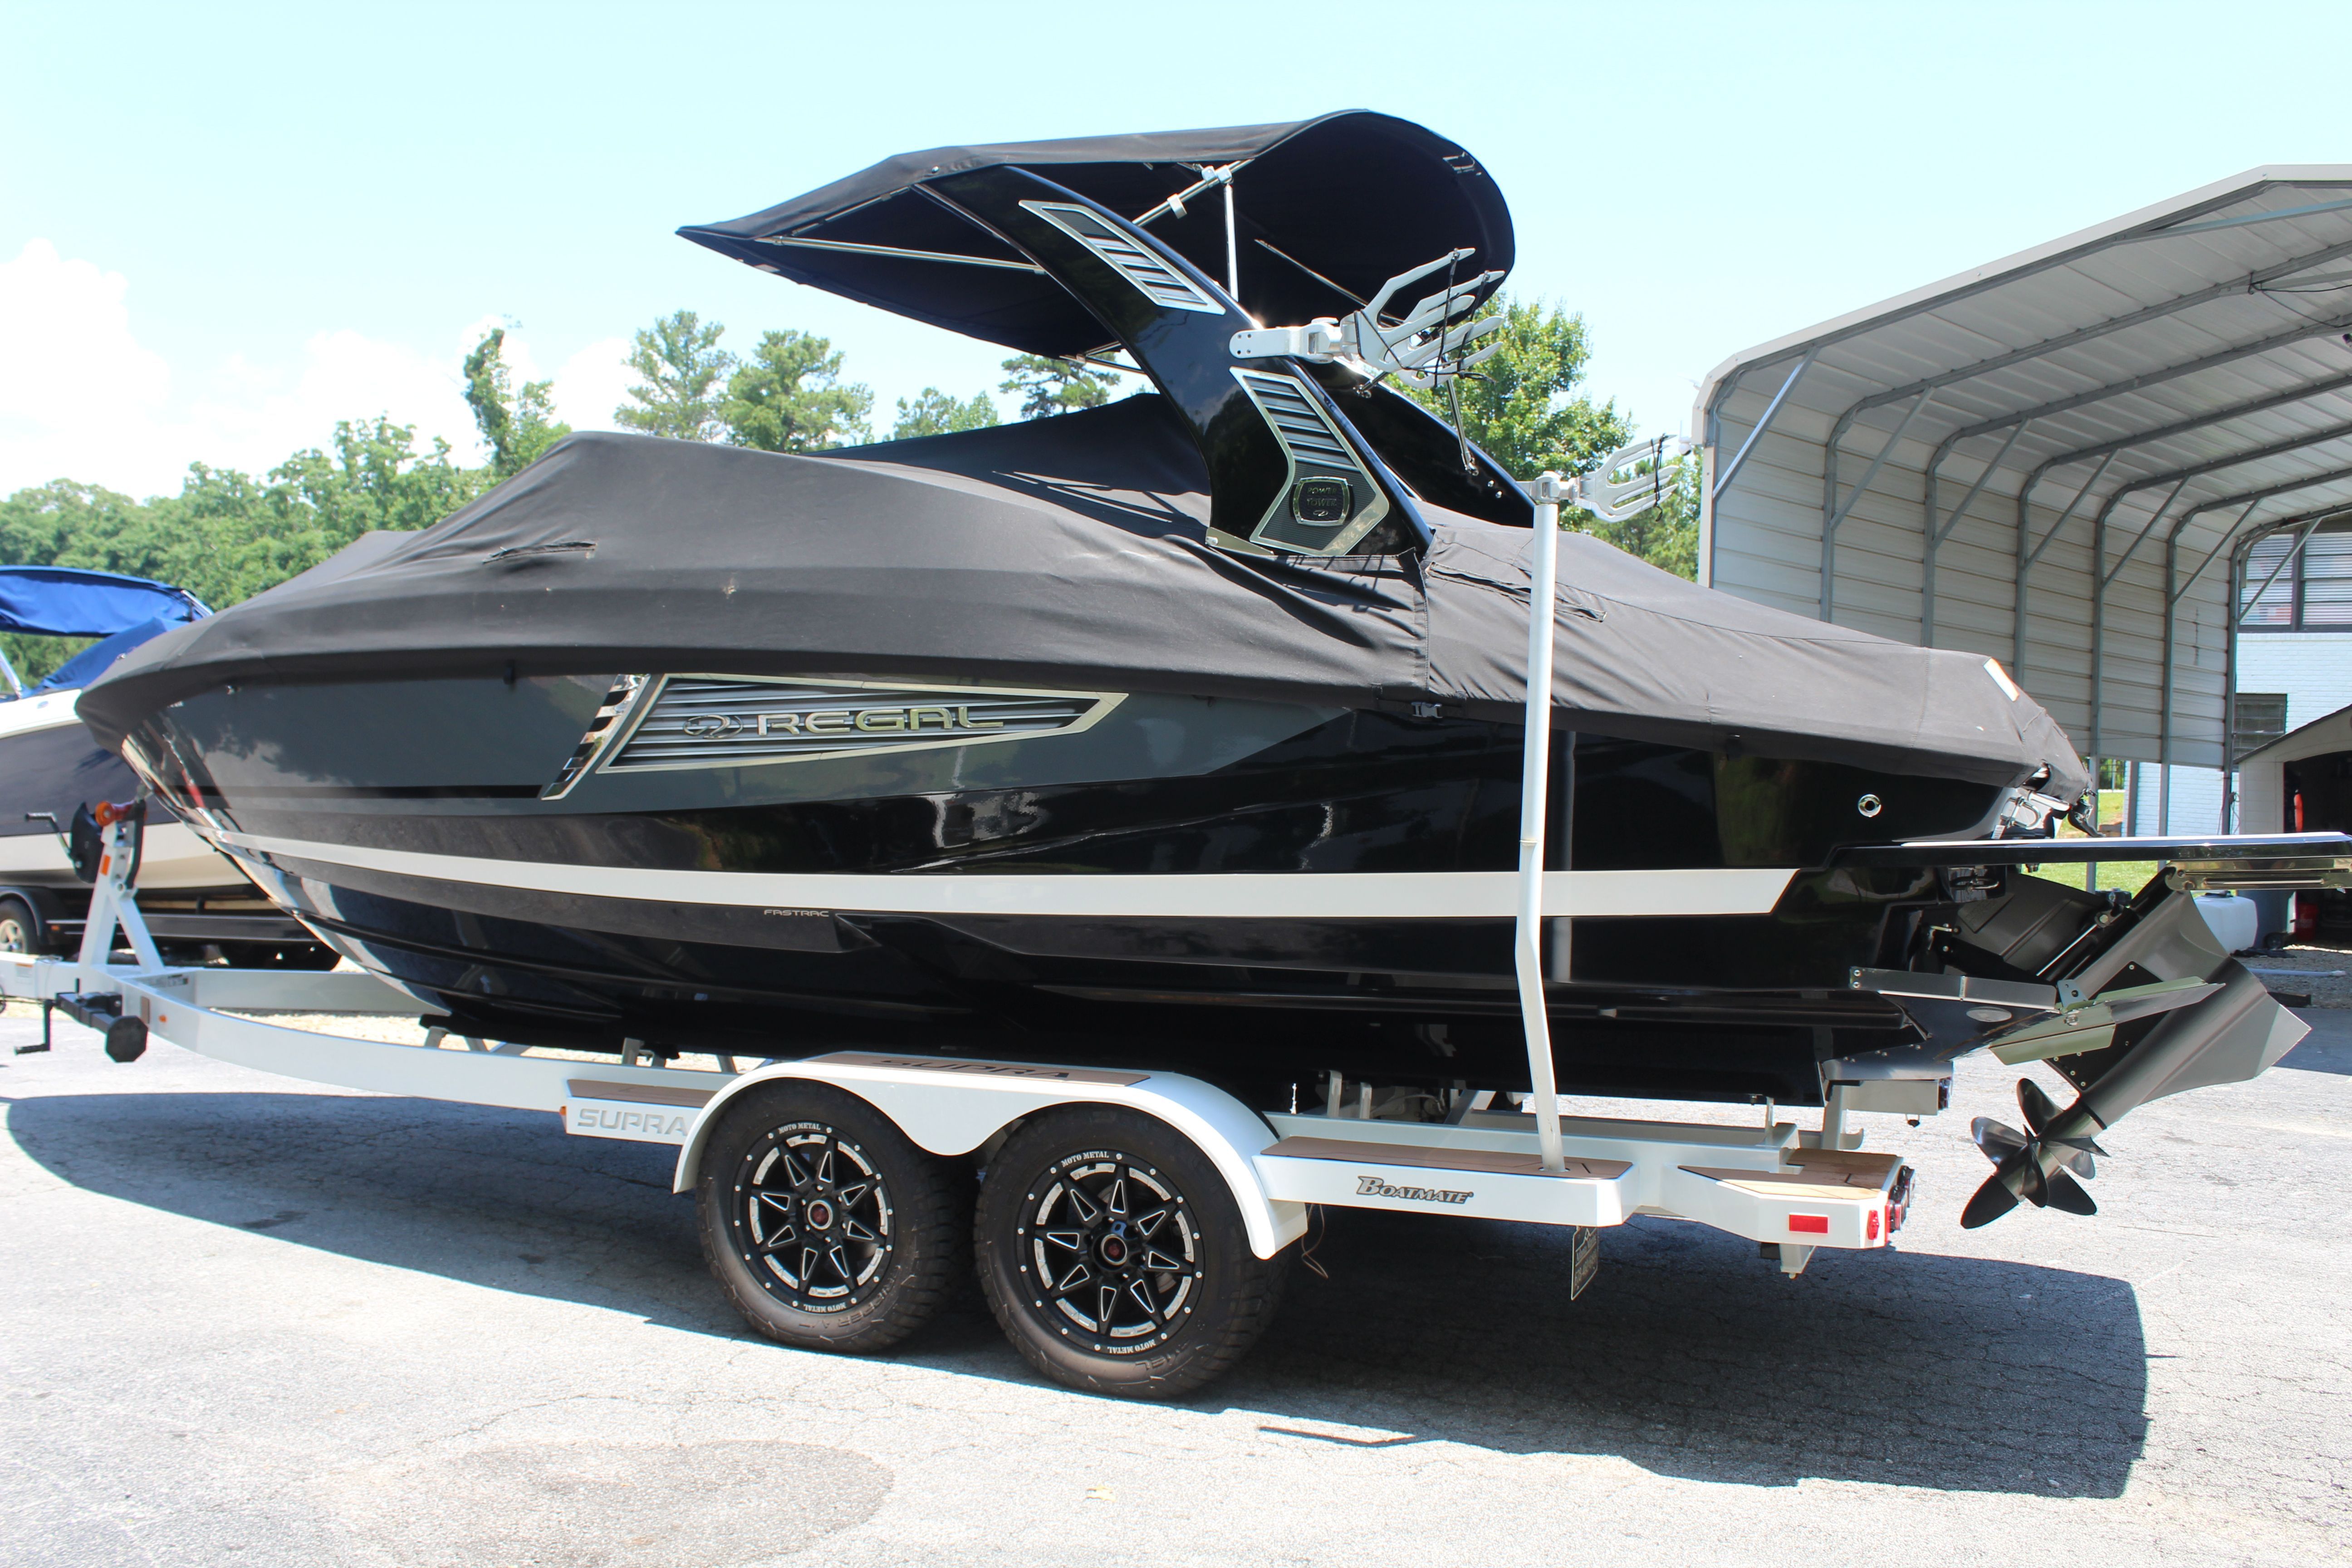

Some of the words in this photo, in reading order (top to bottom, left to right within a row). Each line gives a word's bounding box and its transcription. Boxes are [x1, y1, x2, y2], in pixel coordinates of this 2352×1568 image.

[1307, 498, 1337, 506] TOWER
[758, 706, 1004, 736] REGAL
[872, 1060, 1070, 1078] SUPRA
[577, 1108, 689, 1137] SUPRA
[778, 1123, 797, 1134] MOTO
[798, 1122, 821, 1131] METAL
[1061, 1154, 1082, 1167] MOTO
[1083, 1151, 1109, 1160] METAL
[1356, 1175, 1468, 1205] BOATMATE
[803, 1303, 827, 1313] METAL
[827, 1302, 847, 1312] MOTO
[1107, 1346, 1134, 1354] METAL
[1135, 1339, 1156, 1352] MOTO
